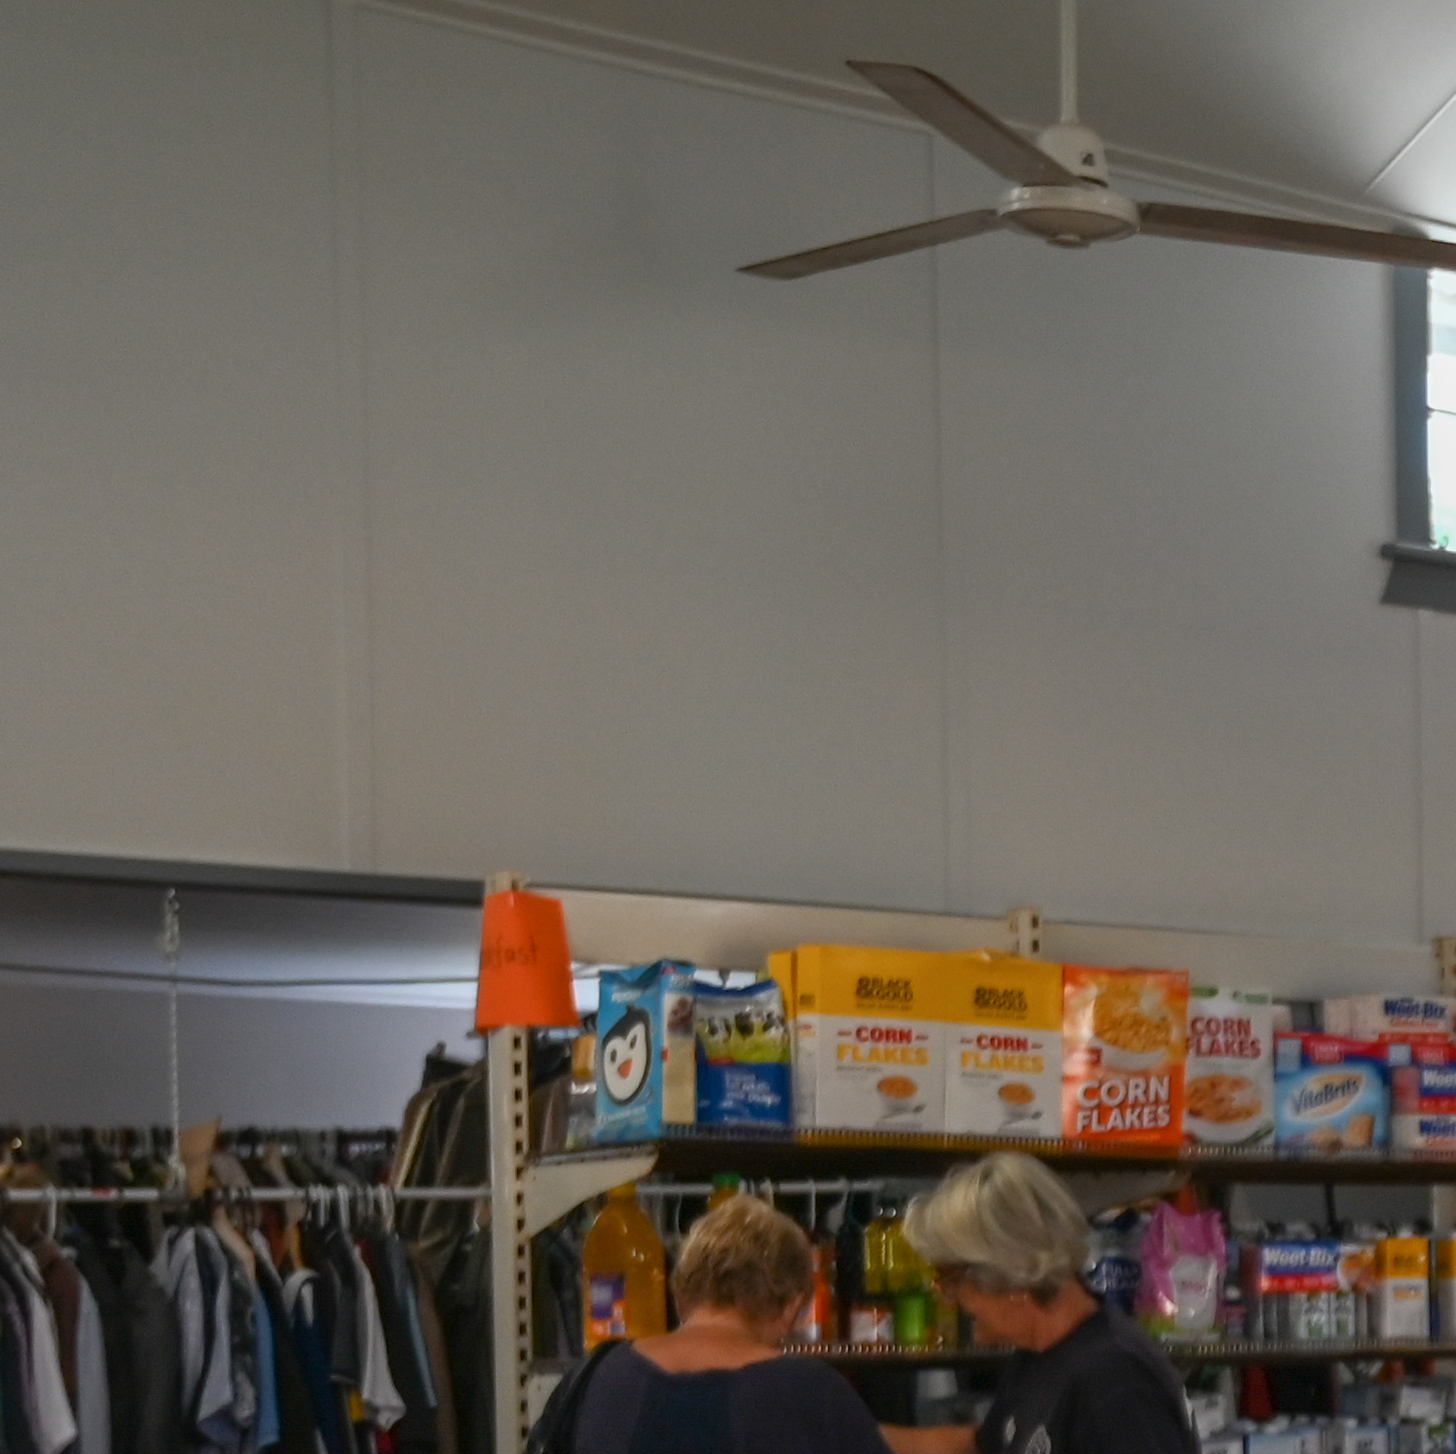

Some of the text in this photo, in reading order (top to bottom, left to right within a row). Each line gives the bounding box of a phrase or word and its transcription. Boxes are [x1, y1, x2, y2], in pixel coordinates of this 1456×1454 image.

[1383, 999, 1447, 1017] Weet-Bix
[855, 1027, 913, 1043] CORN
[1190, 1017, 1252, 1035] CORN
[976, 1034, 1029, 1051] CORN
[1186, 1037, 1262, 1059] FLAKES
[837, 1044, 928, 1066] FLAKES
[960, 1051, 1045, 1073] FLAKES
[1076, 1076, 1170, 1107] CORN
[1076, 1103, 1171, 1133] FLAKES
[1264, 1247, 1336, 1267] Weet-Bix
